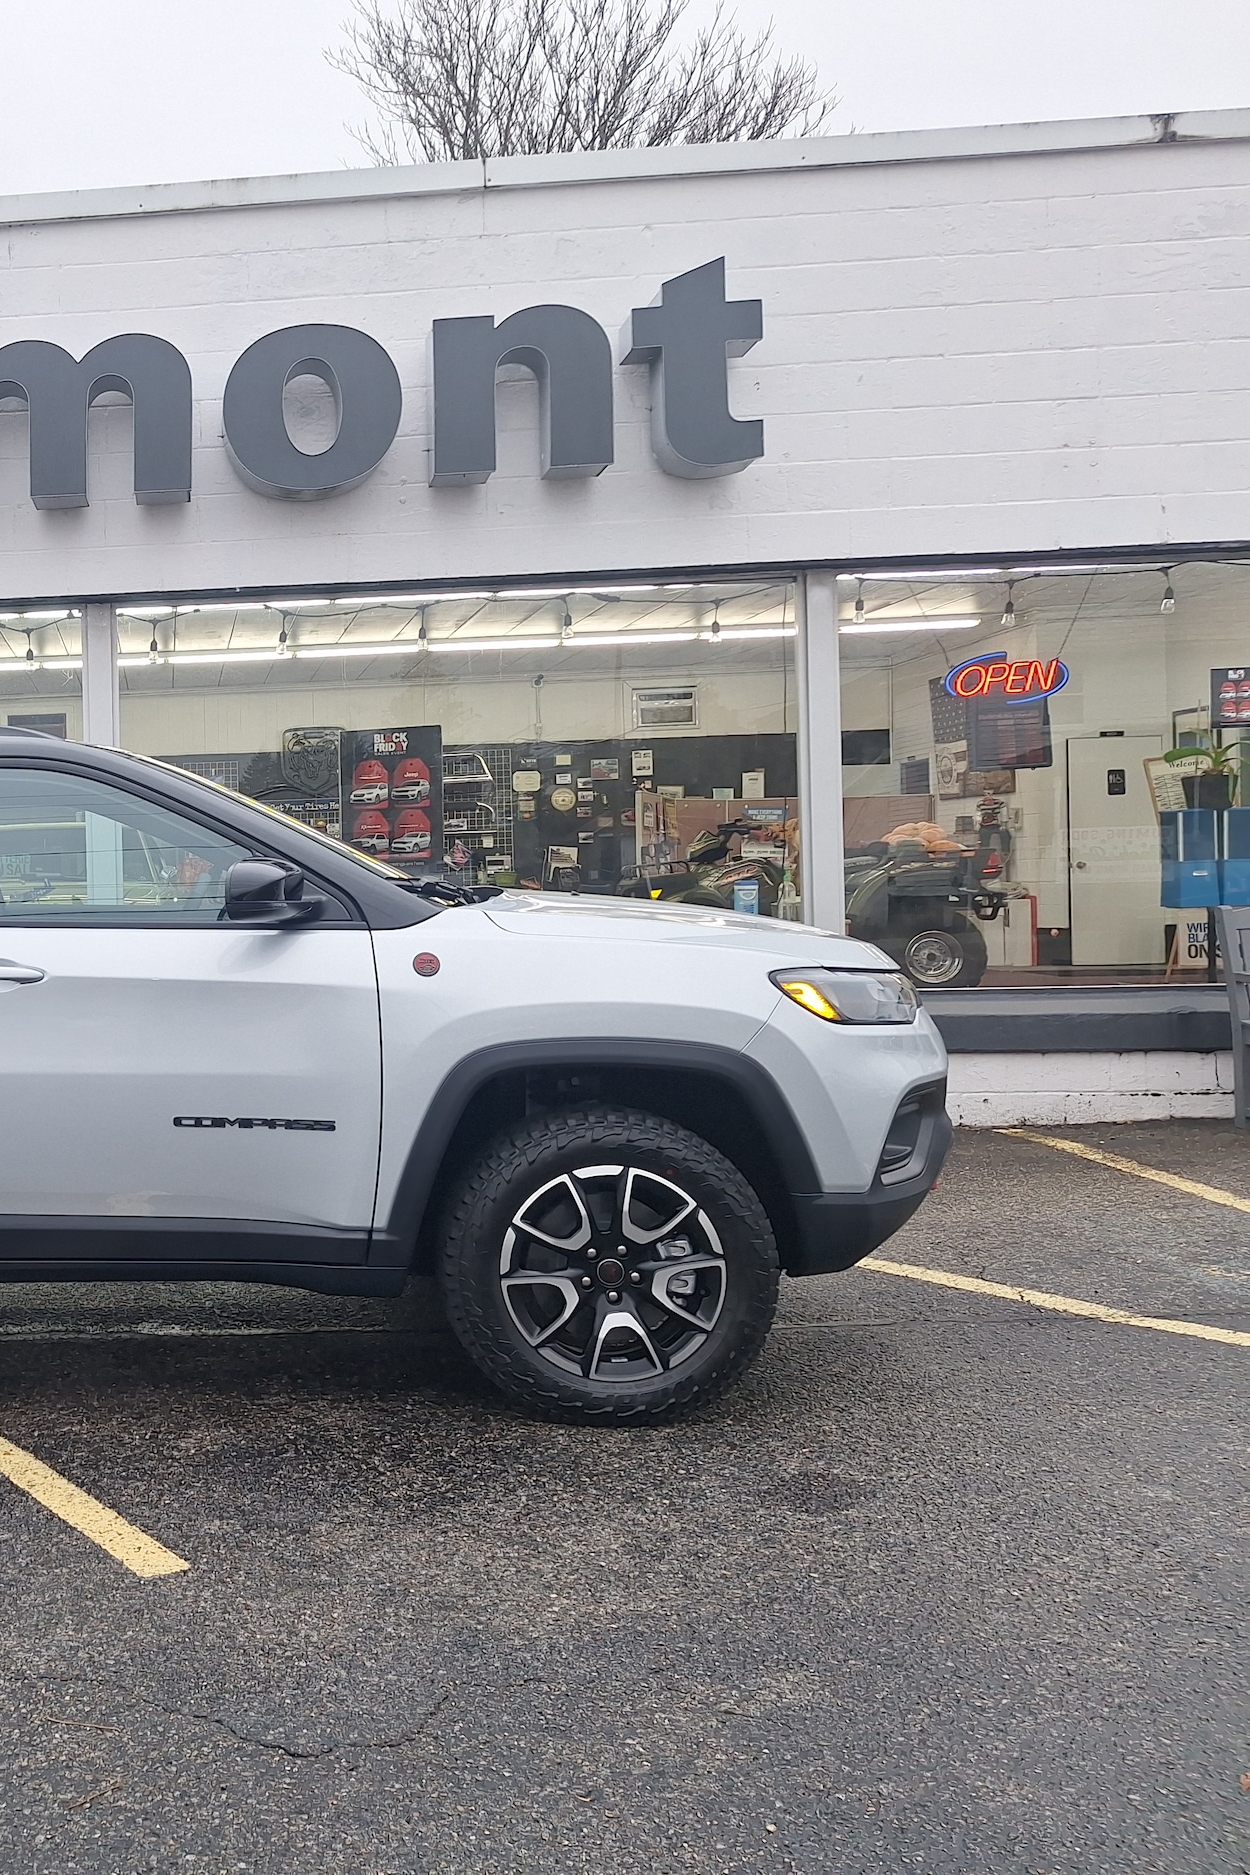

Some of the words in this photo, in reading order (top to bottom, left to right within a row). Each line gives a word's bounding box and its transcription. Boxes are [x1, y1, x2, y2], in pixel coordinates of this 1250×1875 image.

[955, 659, 1058, 698] OPEN
[1170, 760, 1204, 768] Welcome
[284, 803, 304, 811] Your
[305, 802, 329, 810] Tires
[329, 802, 340, 810] He
[173, 1116, 336, 1132] COMPASS
